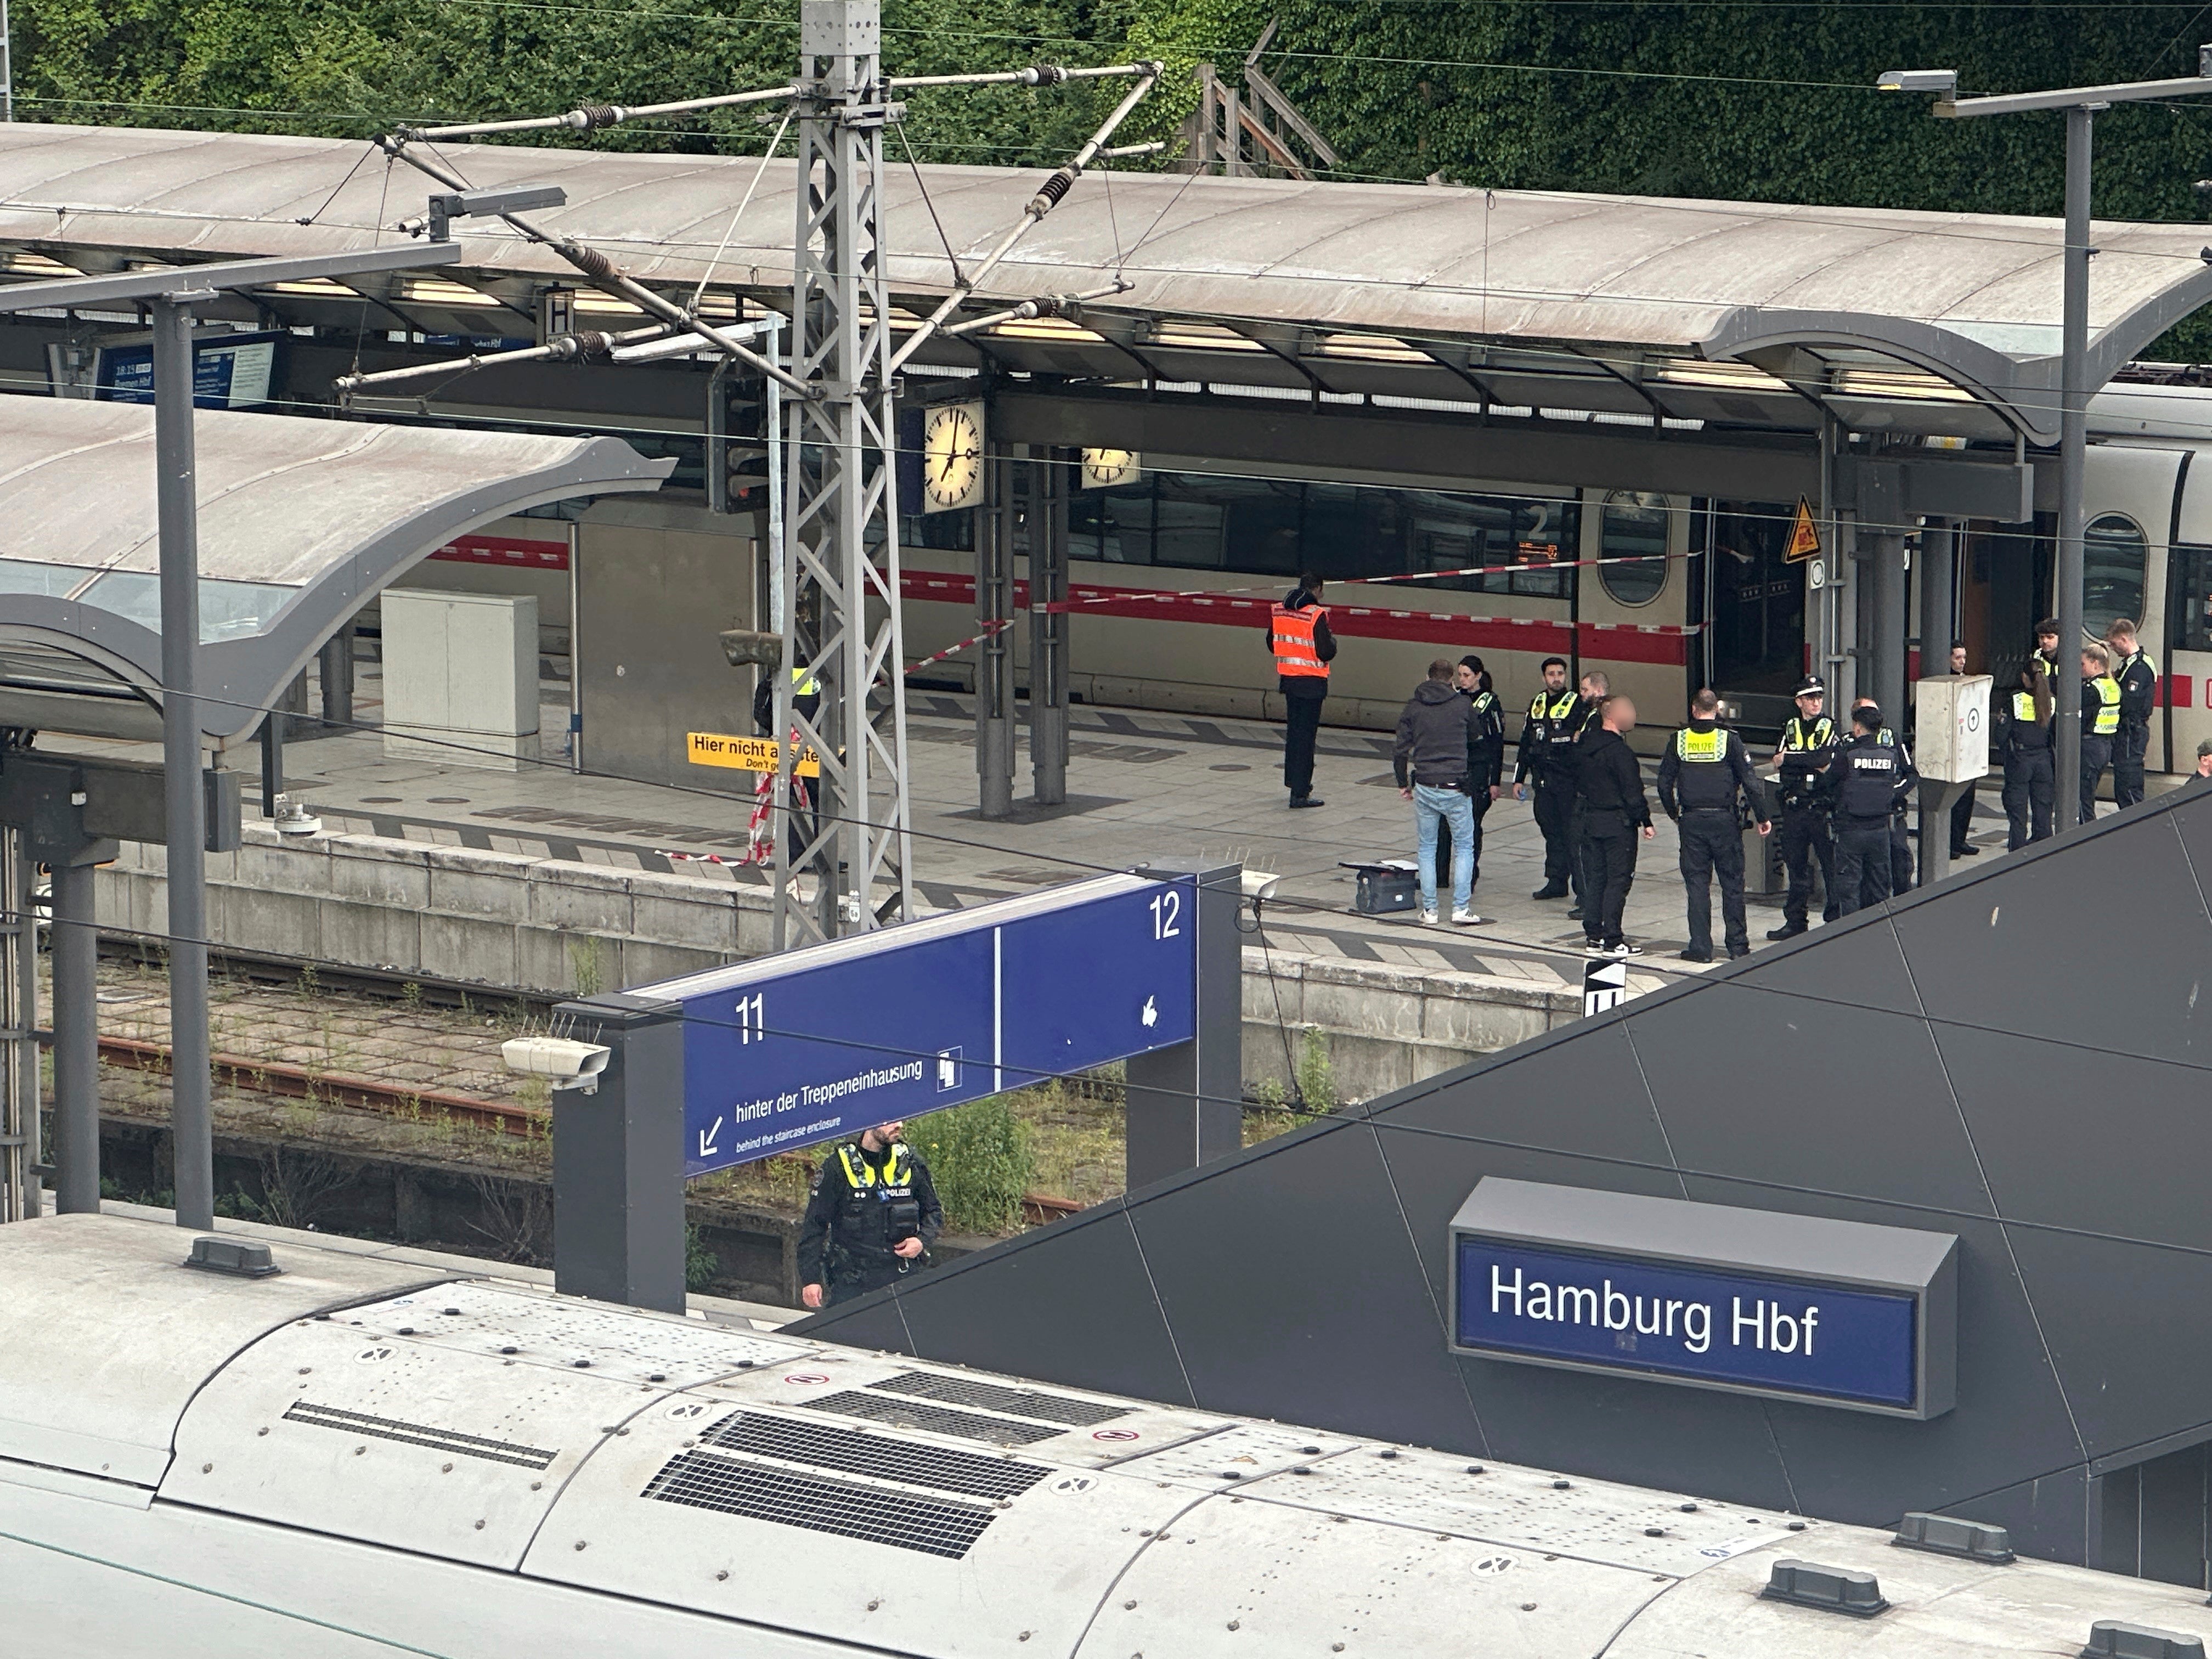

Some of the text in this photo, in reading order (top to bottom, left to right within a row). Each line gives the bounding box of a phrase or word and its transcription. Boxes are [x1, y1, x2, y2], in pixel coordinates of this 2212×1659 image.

[551, 293, 568, 333] H
[1523, 505, 1548, 540] 2
[695, 735, 724, 752] Hier
[729, 741, 765, 757] nicht
[746, 758, 769, 768] Don't
[1688, 743, 1715, 751] POLIZEI
[1854, 758, 1892, 769] POLIZEI
[1149, 890, 1180, 940] 12
[736, 992, 763, 1045] 11
[736, 1060, 923, 1124] hinter der Treppeneinhausung
[736, 1116, 841, 1153] behind the staircase enclosure
[1492, 1265, 1819, 1356] Hamburg Hbf
